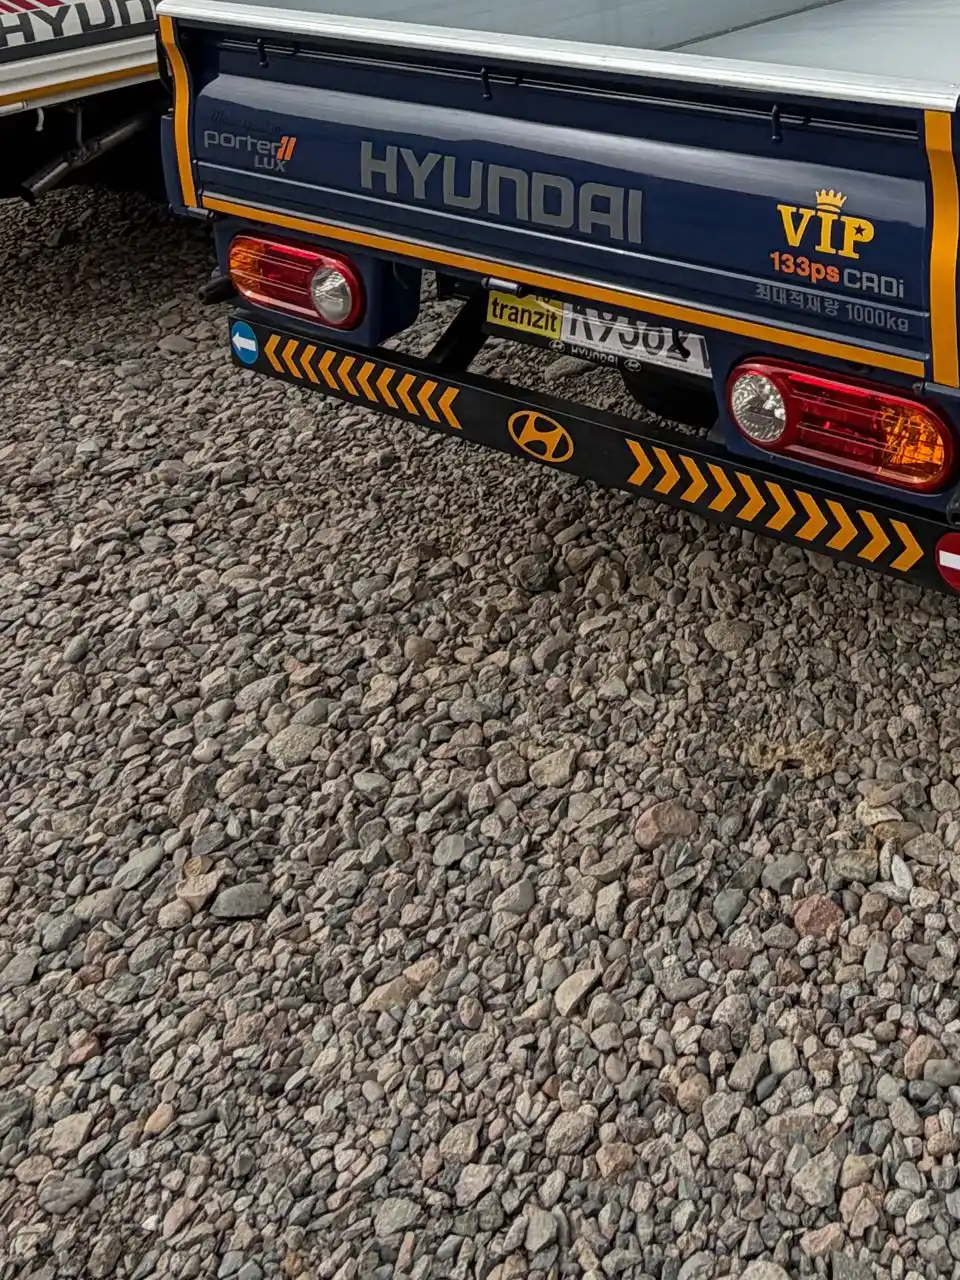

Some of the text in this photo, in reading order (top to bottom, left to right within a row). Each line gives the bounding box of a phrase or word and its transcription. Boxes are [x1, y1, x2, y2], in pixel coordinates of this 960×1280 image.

[254, 155, 286, 173] LUX
[360, 140, 643, 245] HYUNDAI
[776, 203, 875, 260] VIP
[769, 251, 905, 299] 133ps CRDi
[491, 296, 559, 333] tranzit
[845, 303, 910, 332] 1000kg
